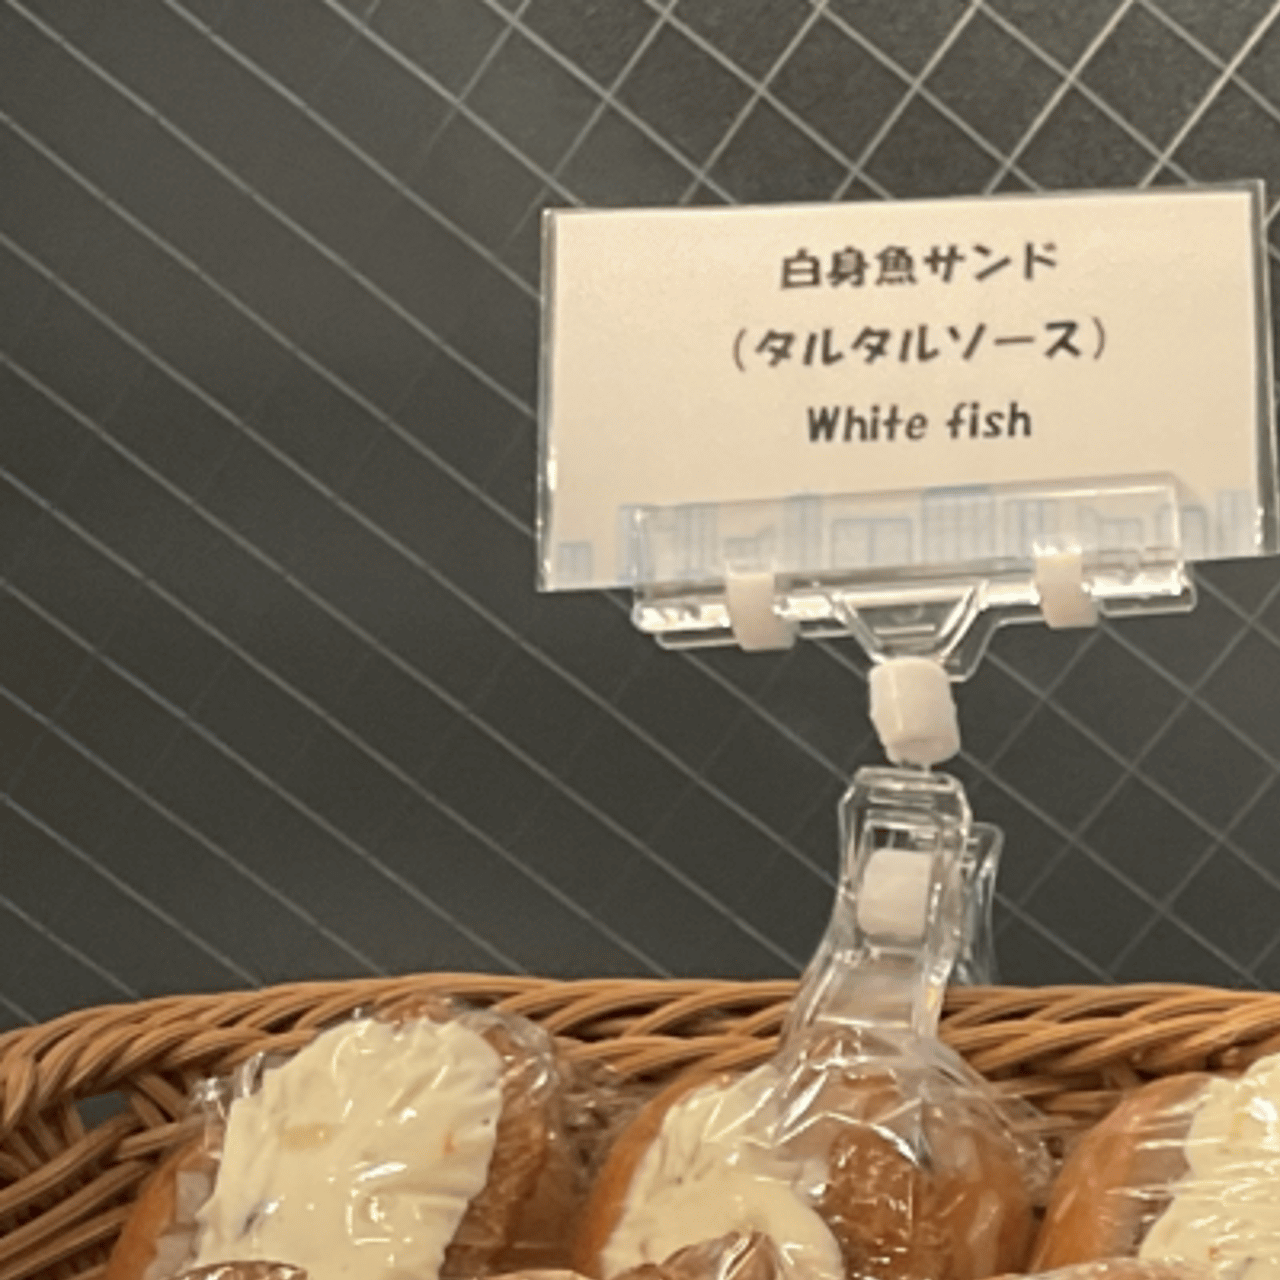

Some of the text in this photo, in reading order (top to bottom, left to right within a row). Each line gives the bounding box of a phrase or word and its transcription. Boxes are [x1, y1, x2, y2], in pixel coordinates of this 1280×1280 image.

[780, 241, 1060, 291] 白身魚サンド
[806, 400, 1033, 444] White fish
